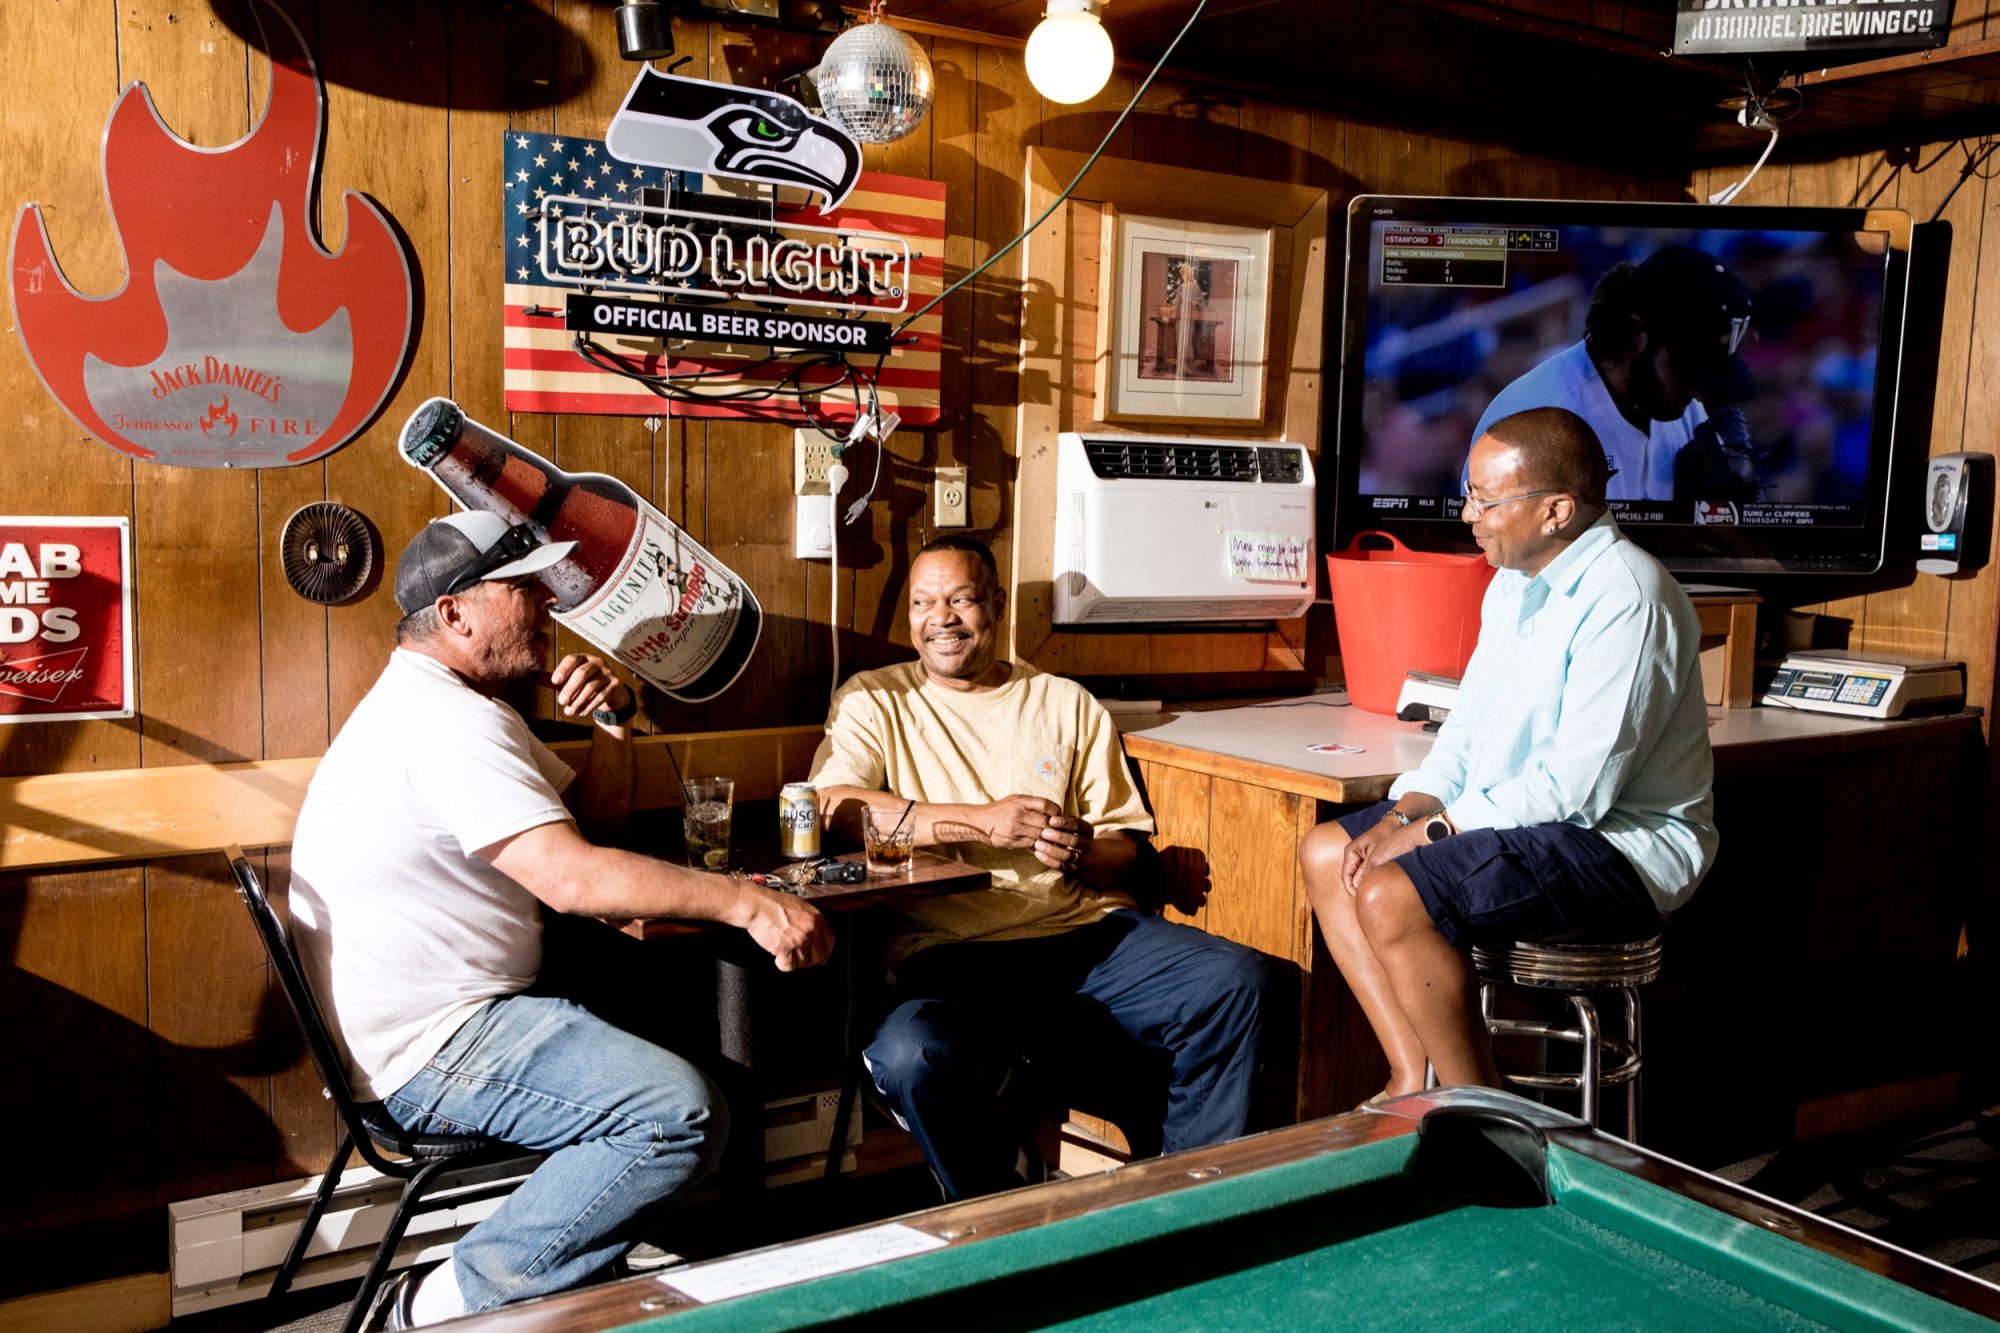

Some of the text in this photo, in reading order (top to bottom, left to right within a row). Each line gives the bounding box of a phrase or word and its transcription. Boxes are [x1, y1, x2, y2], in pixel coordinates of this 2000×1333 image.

[1713, 14, 1796, 40] BARREL
[1799, 10, 1901, 37] BREWING
[1437, 236, 1444, 245] 3
[1498, 238, 1505, 246] 0
[557, 216, 899, 297] BUD LIGHT
[593, 303, 868, 346] OFFICIAL BEER SPONSOR
[149, 355, 285, 404] JACK DANIEL'S
[112, 413, 320, 435] Tennessee FIRE
[1372, 497, 1409, 509] ESPN
[1447, 498, 1463, 507] Red
[1448, 508, 1458, 517] TB
[1644, 512, 1650, 521] 2
[590, 537, 661, 627] LAGUNITAS
[629, 631, 671, 663] Little
